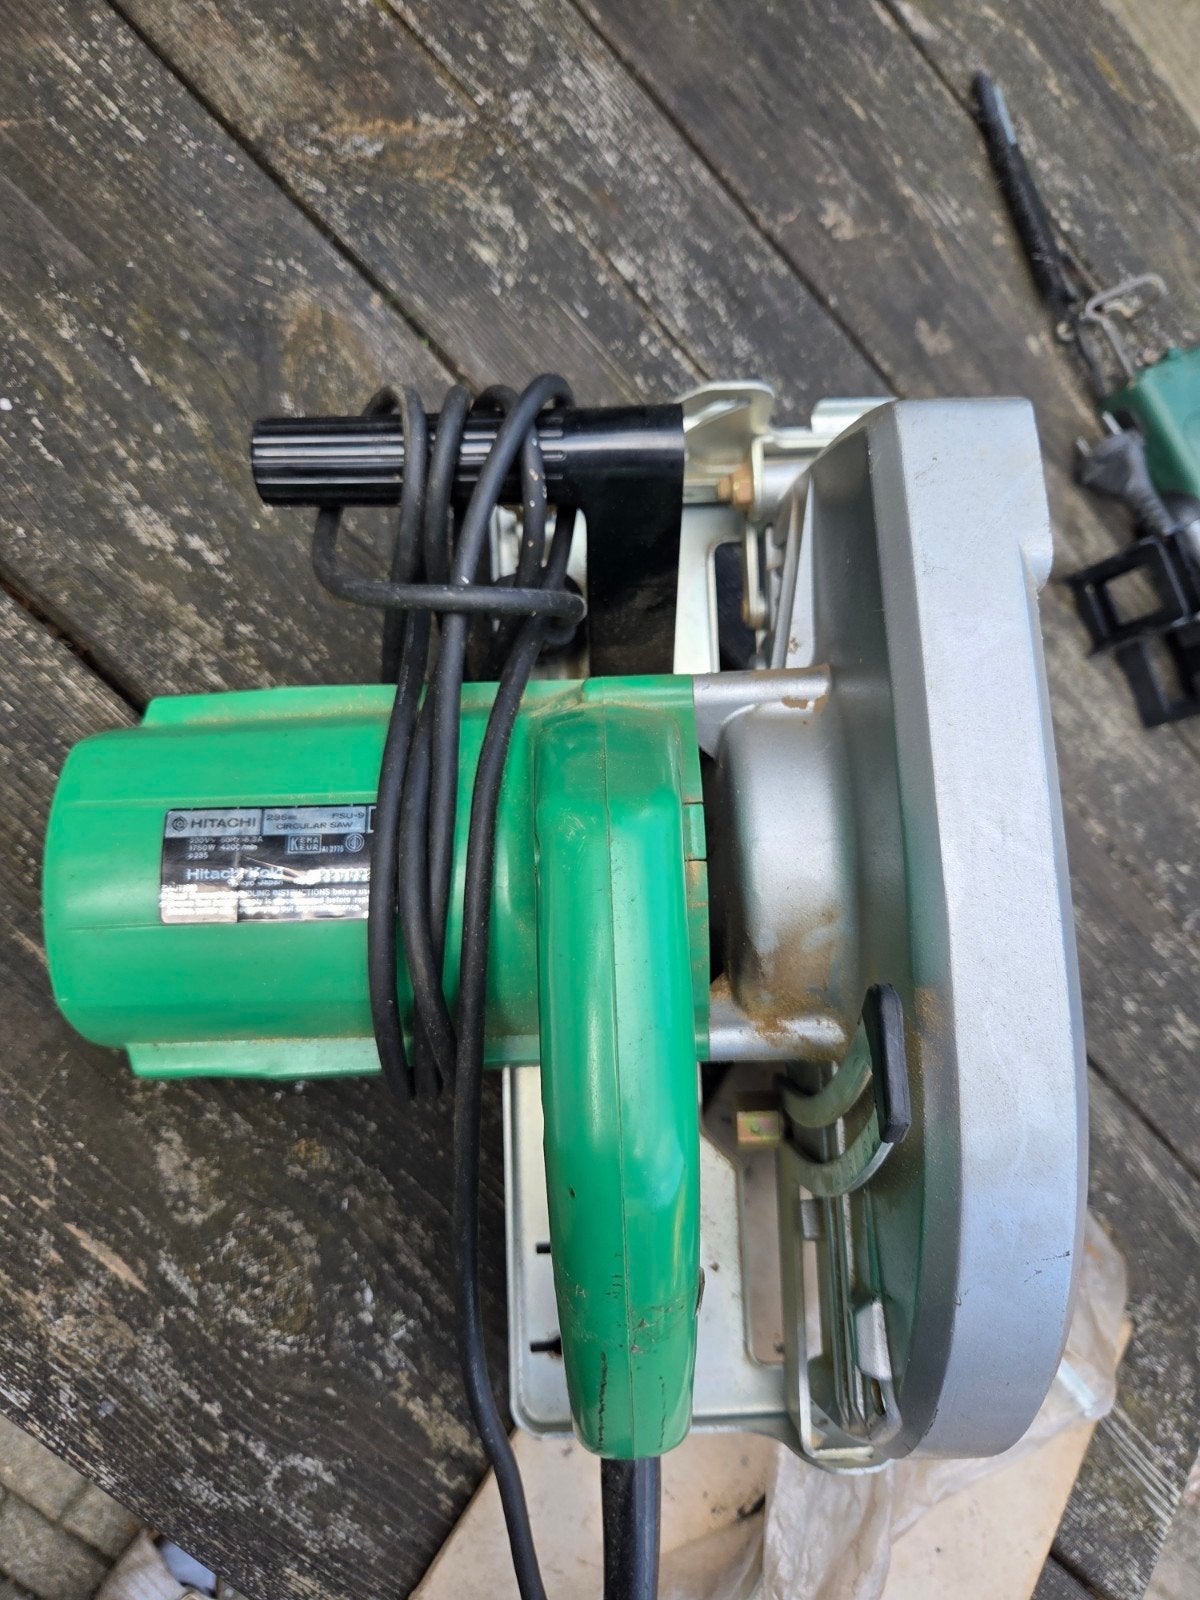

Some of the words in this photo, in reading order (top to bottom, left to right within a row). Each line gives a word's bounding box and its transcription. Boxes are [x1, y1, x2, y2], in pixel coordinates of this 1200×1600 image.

[190, 817, 256, 830] HITACHI
[275, 822, 327, 830] CIRCULAR
[329, 821, 354, 829] SAW
